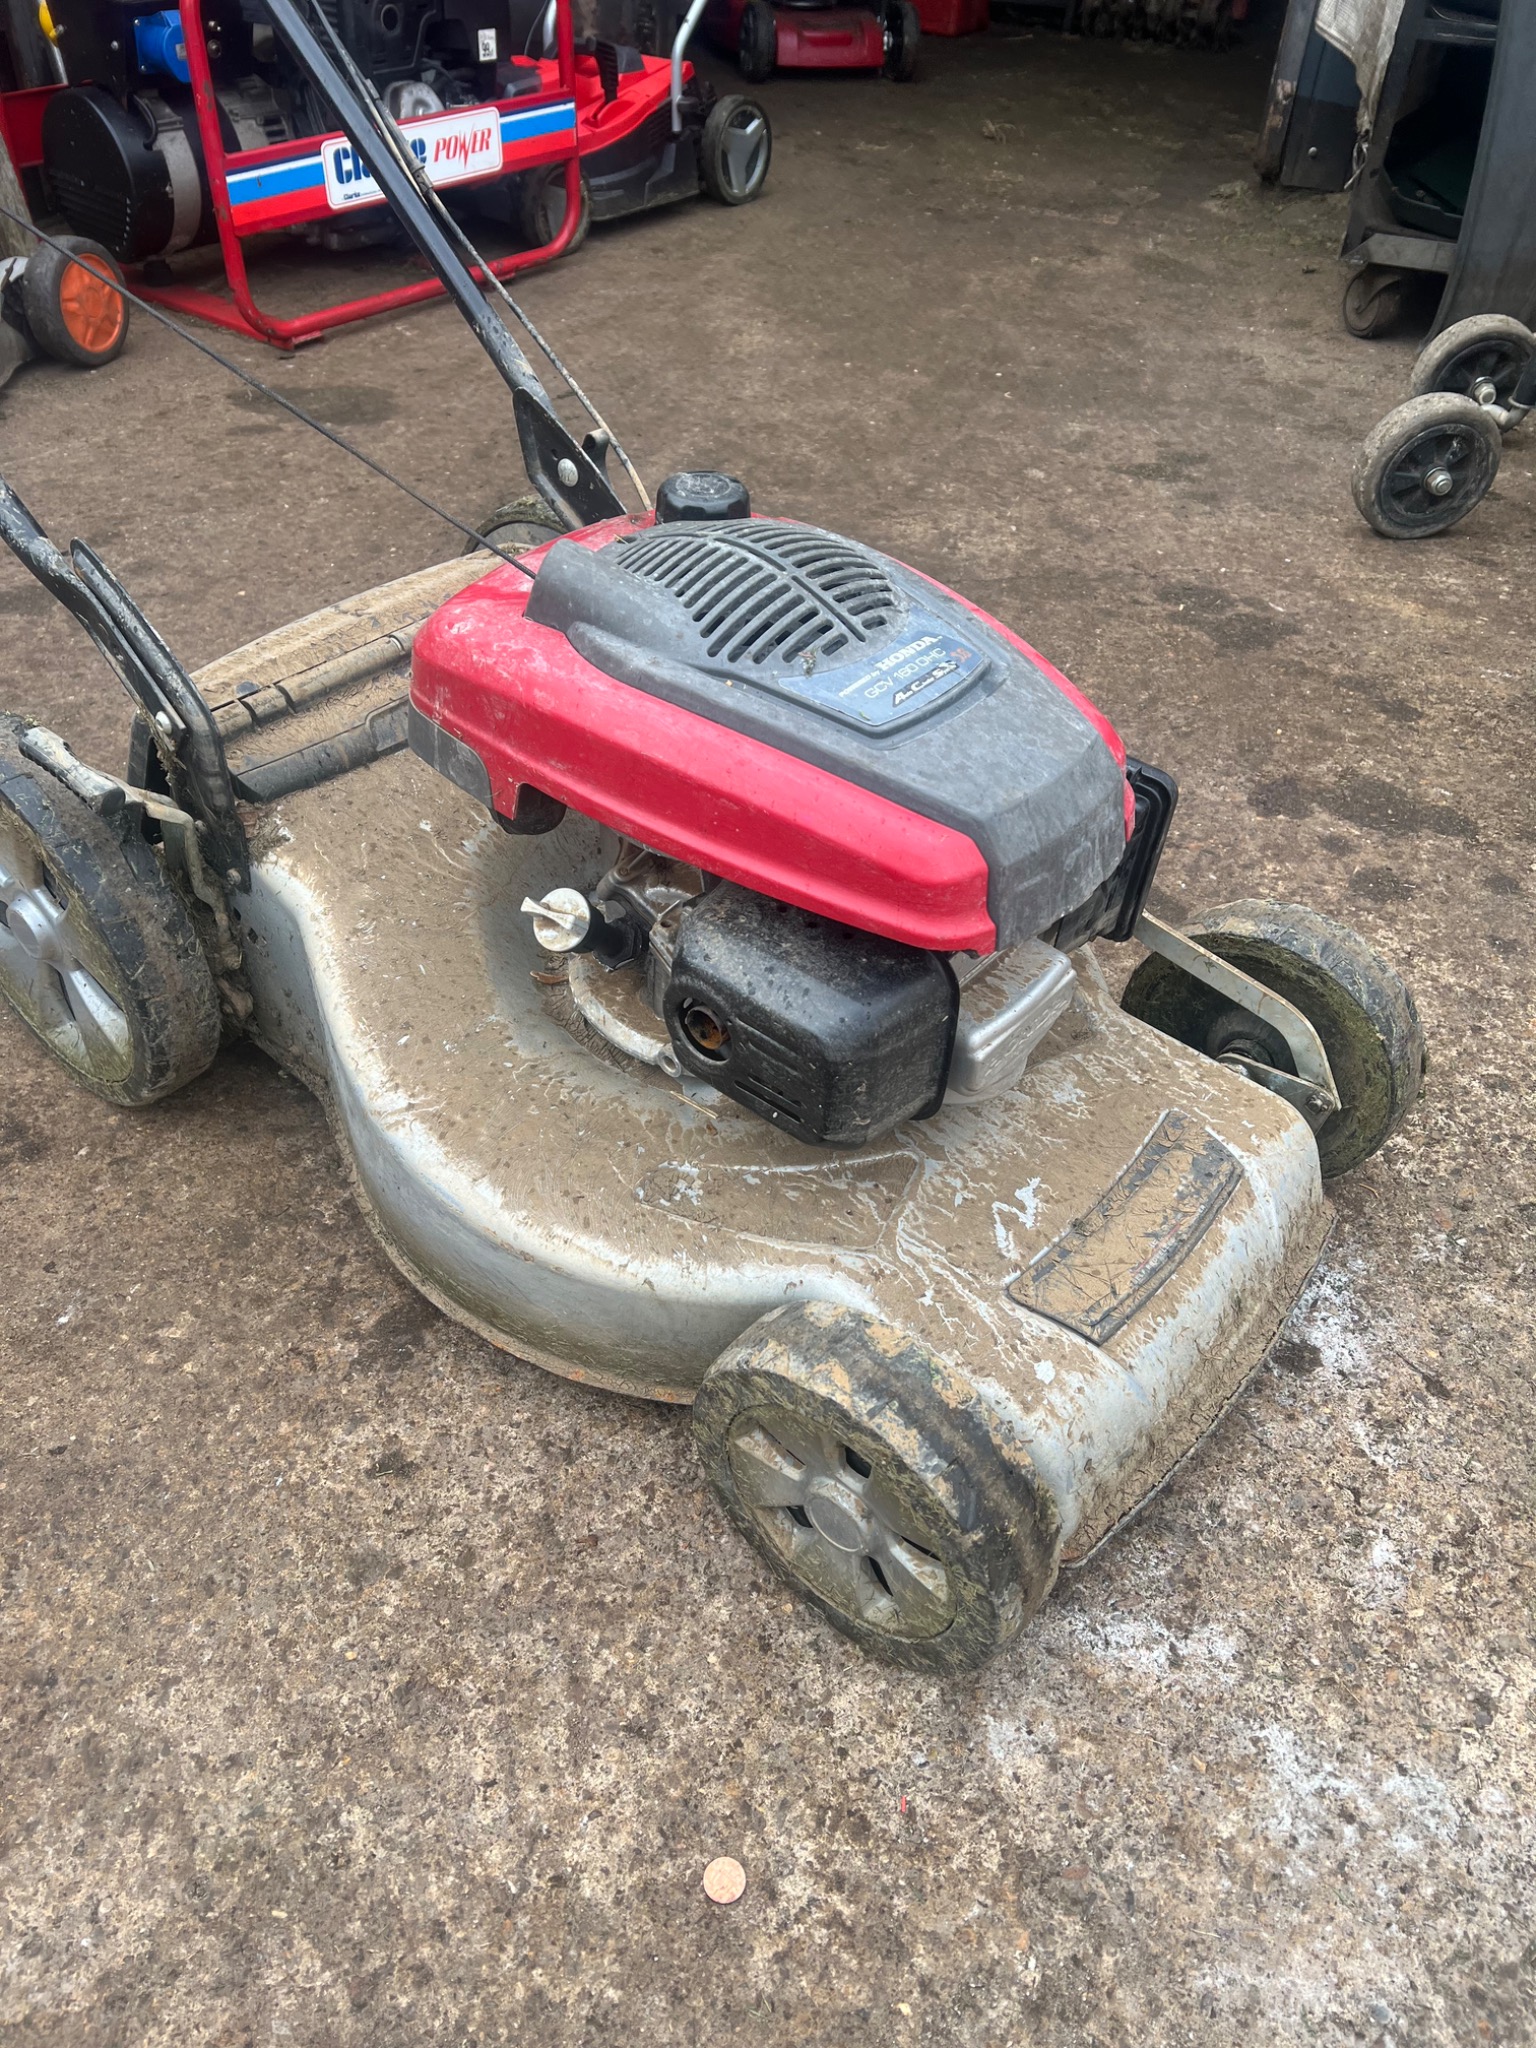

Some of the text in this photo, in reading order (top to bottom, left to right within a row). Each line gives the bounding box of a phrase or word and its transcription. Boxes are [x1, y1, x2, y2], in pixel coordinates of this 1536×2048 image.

[433, 122, 492, 168] POWER
[864, 647, 946, 698] GCV 160 OHC
[874, 636, 939, 671] HONDA
